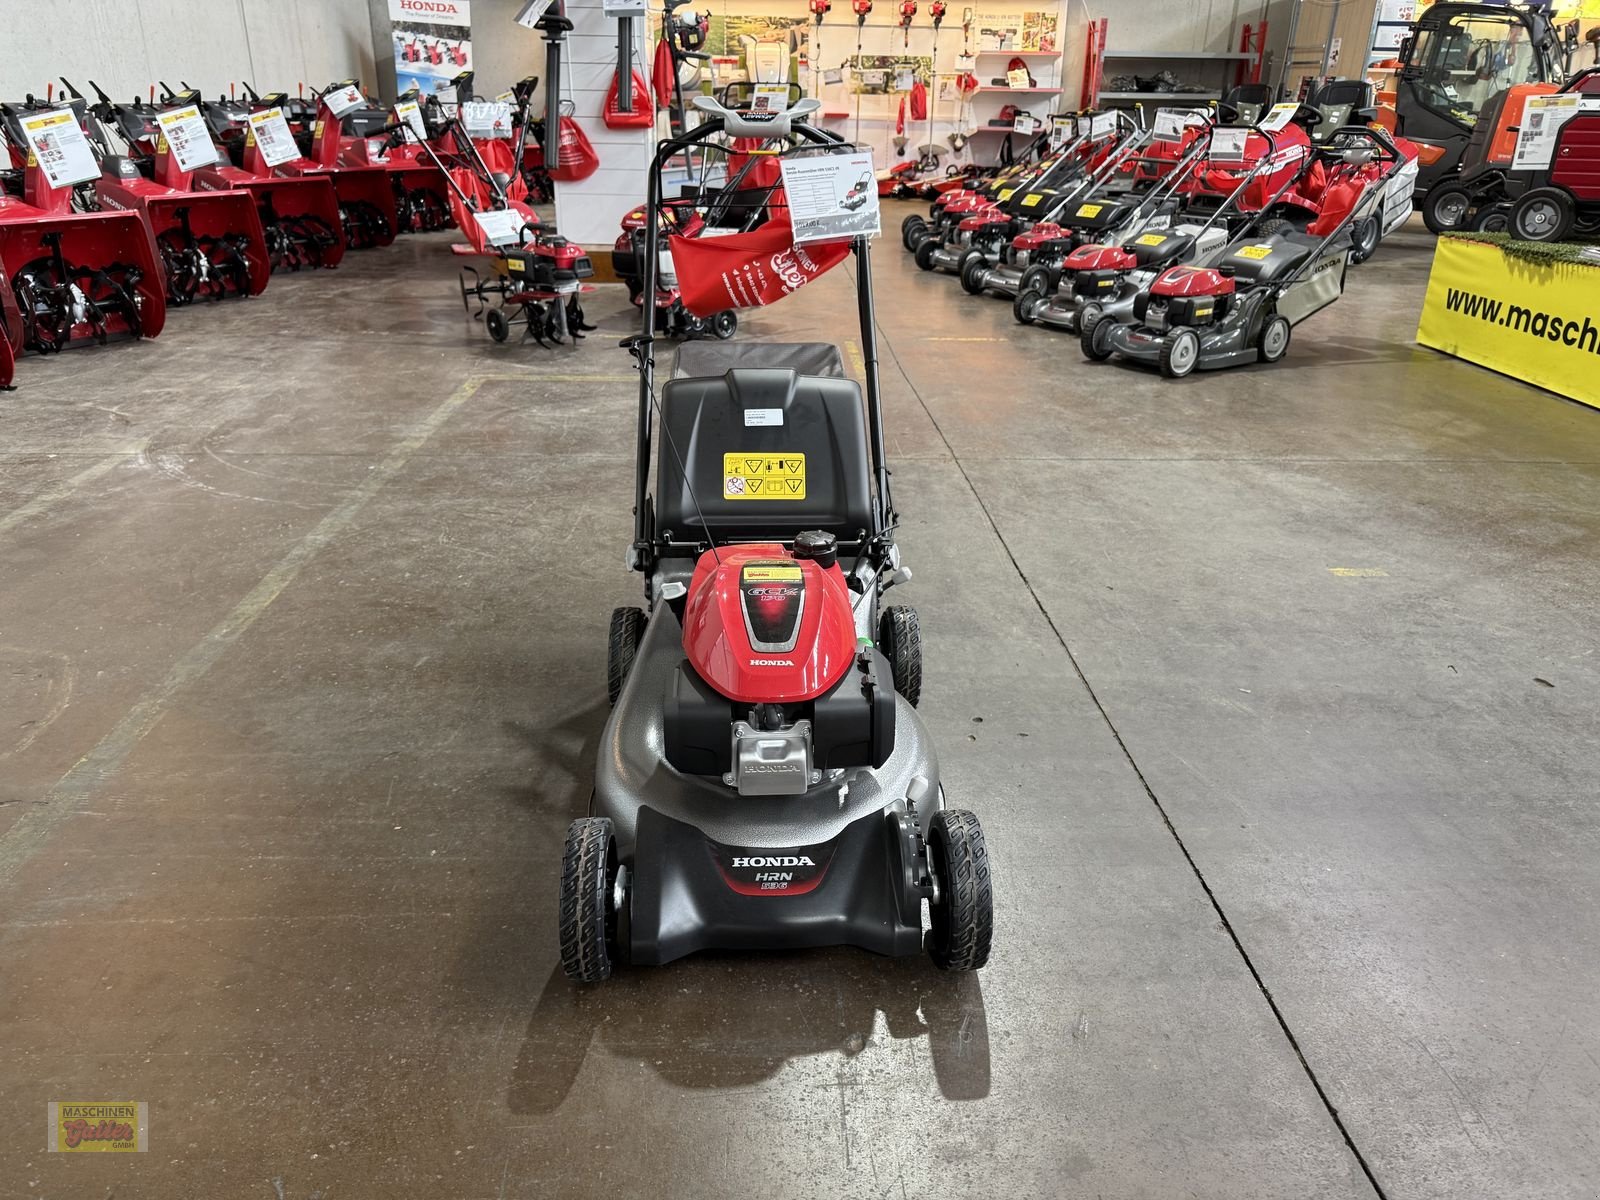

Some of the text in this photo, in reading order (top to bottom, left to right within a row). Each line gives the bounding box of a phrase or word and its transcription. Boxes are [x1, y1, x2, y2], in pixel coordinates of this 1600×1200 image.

[401, 0, 458, 14] HONDA
[103, 194, 128, 212] HOND
[744, 765, 801, 773] HONDA
[732, 856, 816, 867] HONDA
[755, 872, 793, 881] HRN
